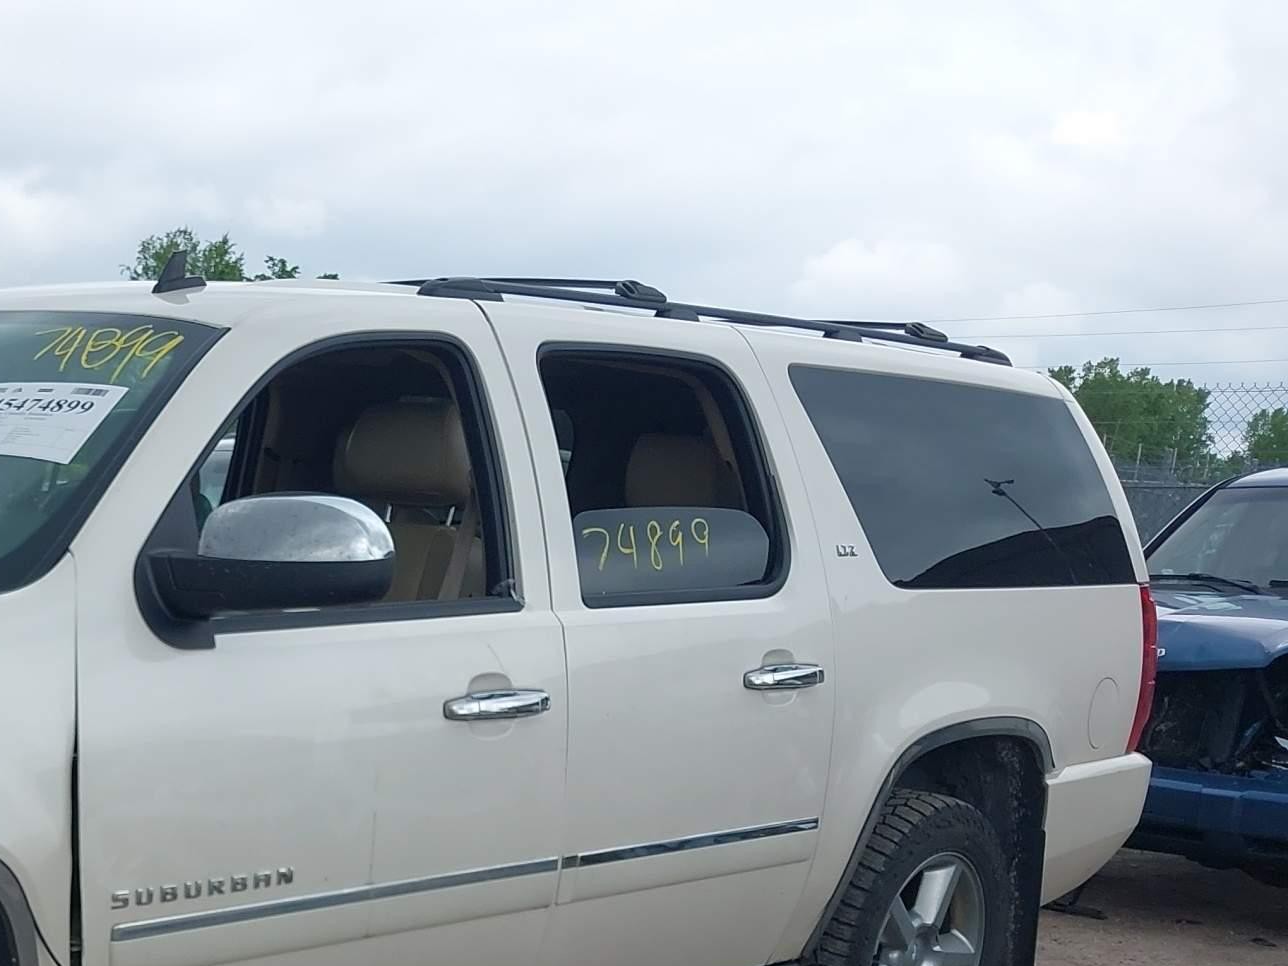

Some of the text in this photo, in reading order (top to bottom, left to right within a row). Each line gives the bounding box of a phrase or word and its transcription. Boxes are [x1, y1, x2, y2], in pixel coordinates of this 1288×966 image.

[34, 325, 184, 384] 74899
[582, 518, 710, 571] 74899
[110, 866, 294, 910] SUBURBAN
